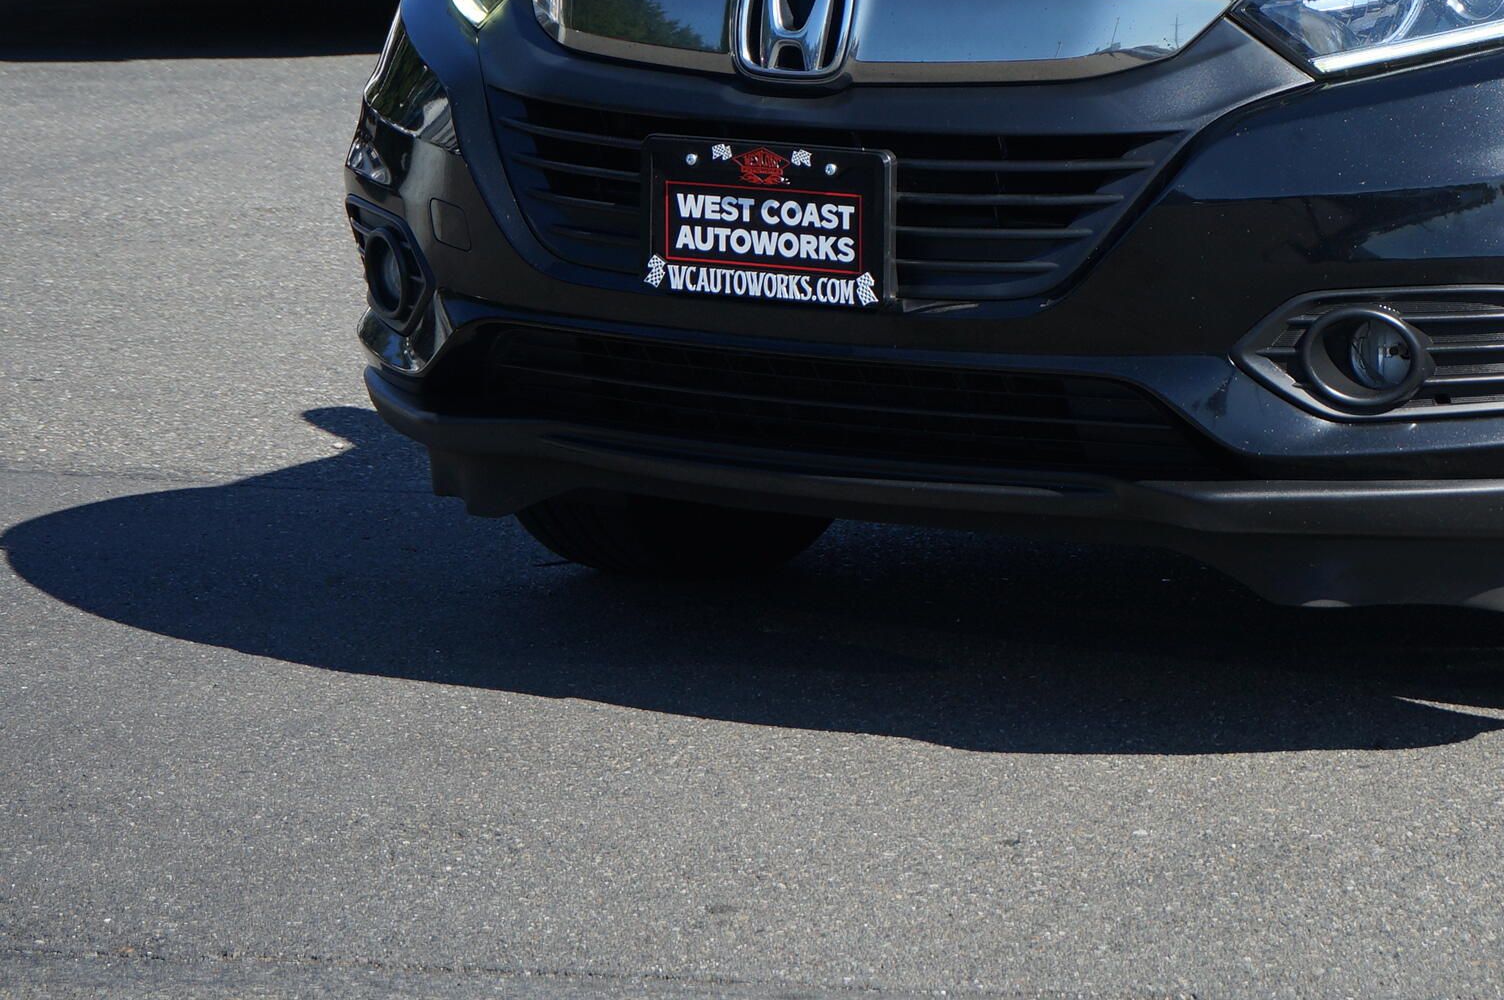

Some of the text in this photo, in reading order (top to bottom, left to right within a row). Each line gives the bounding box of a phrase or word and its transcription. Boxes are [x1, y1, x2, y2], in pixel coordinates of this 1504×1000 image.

[676, 193, 855, 230] WEST COAST
[675, 225, 855, 263] AUTOWORKS
[667, 264, 855, 305] WCAUTOWORKS.COM
